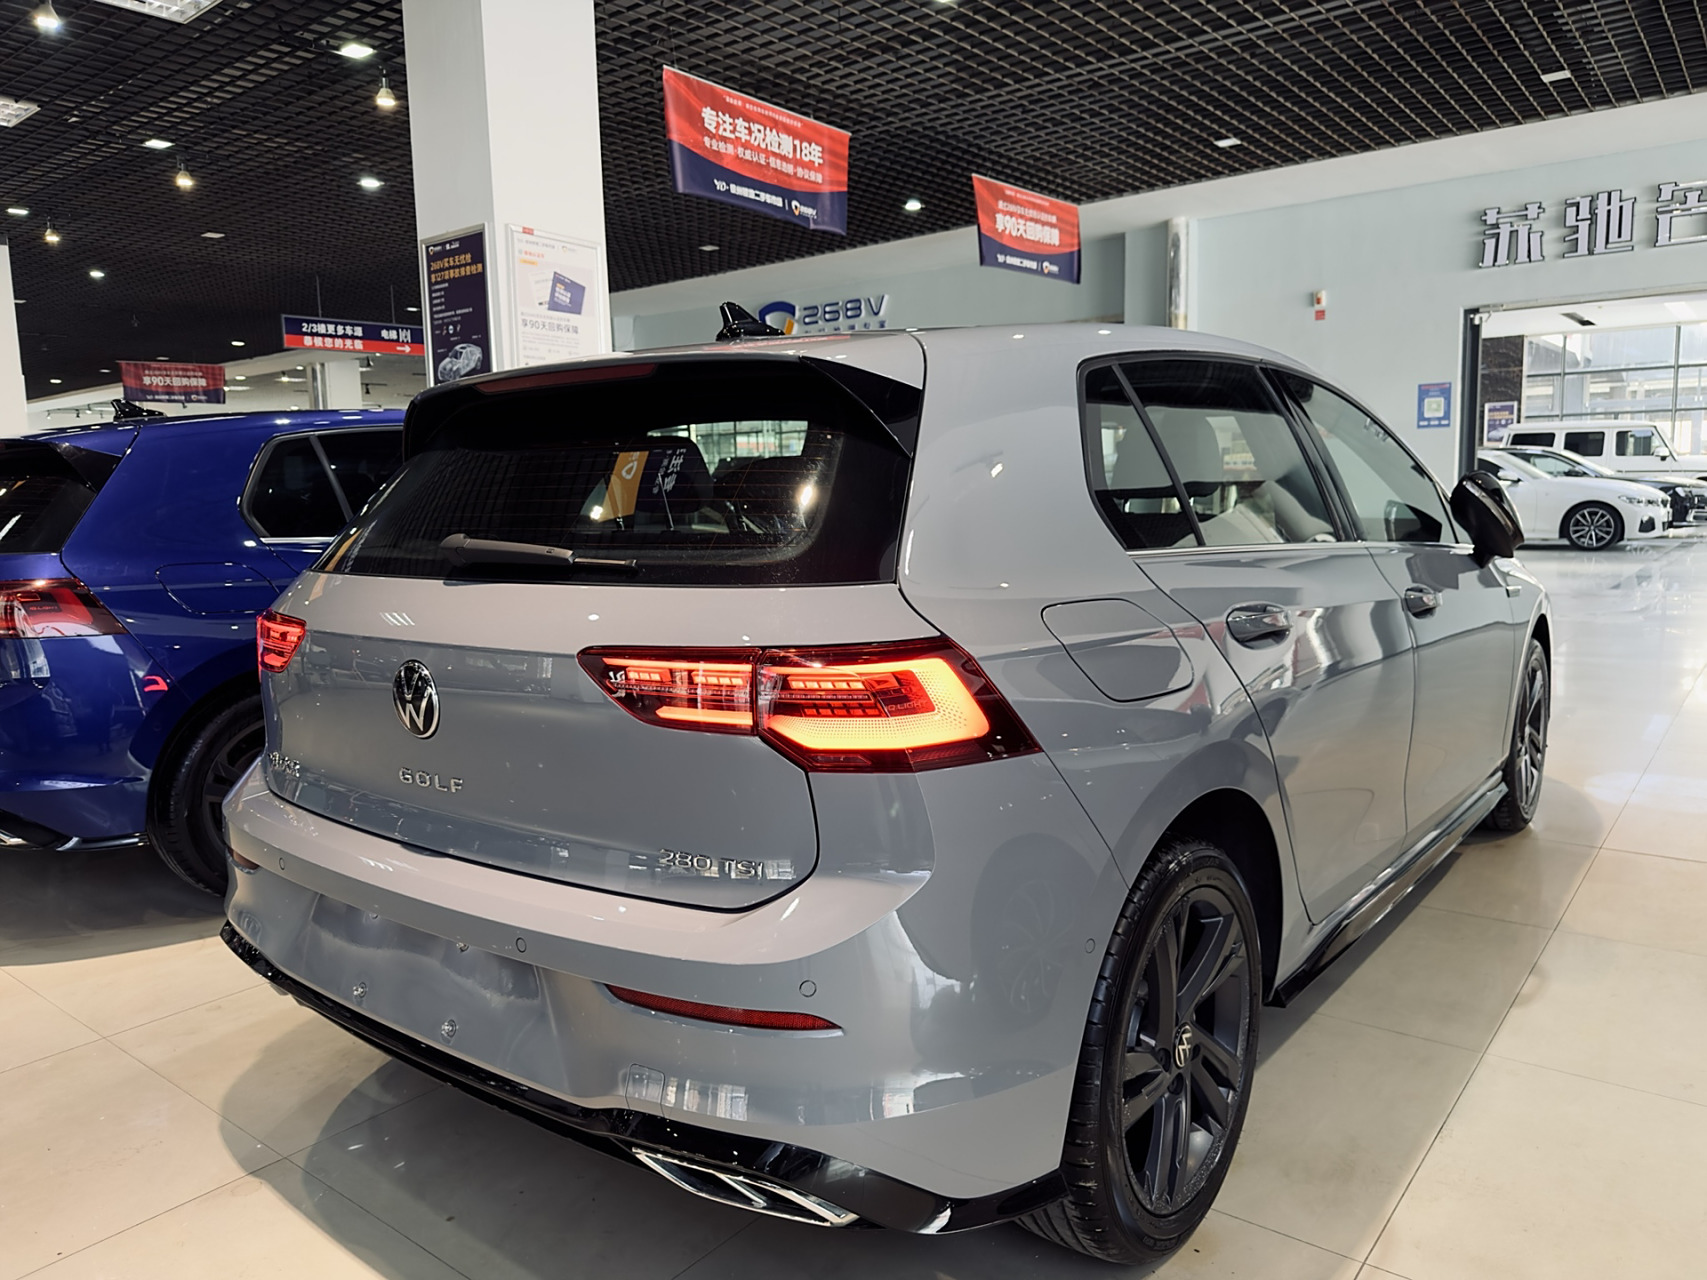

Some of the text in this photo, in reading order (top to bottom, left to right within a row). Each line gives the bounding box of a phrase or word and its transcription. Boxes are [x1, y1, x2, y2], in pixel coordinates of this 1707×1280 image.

[701, 106, 824, 168] 专注车况检测18年
[802, 294, 888, 326] 268V
[301, 322, 398, 340] 2/3楼更多车源 电梯
[303, 335, 363, 350] 恭候您的光临
[399, 766, 464, 793] GOLF
[659, 848, 765, 880] 280 TSI
